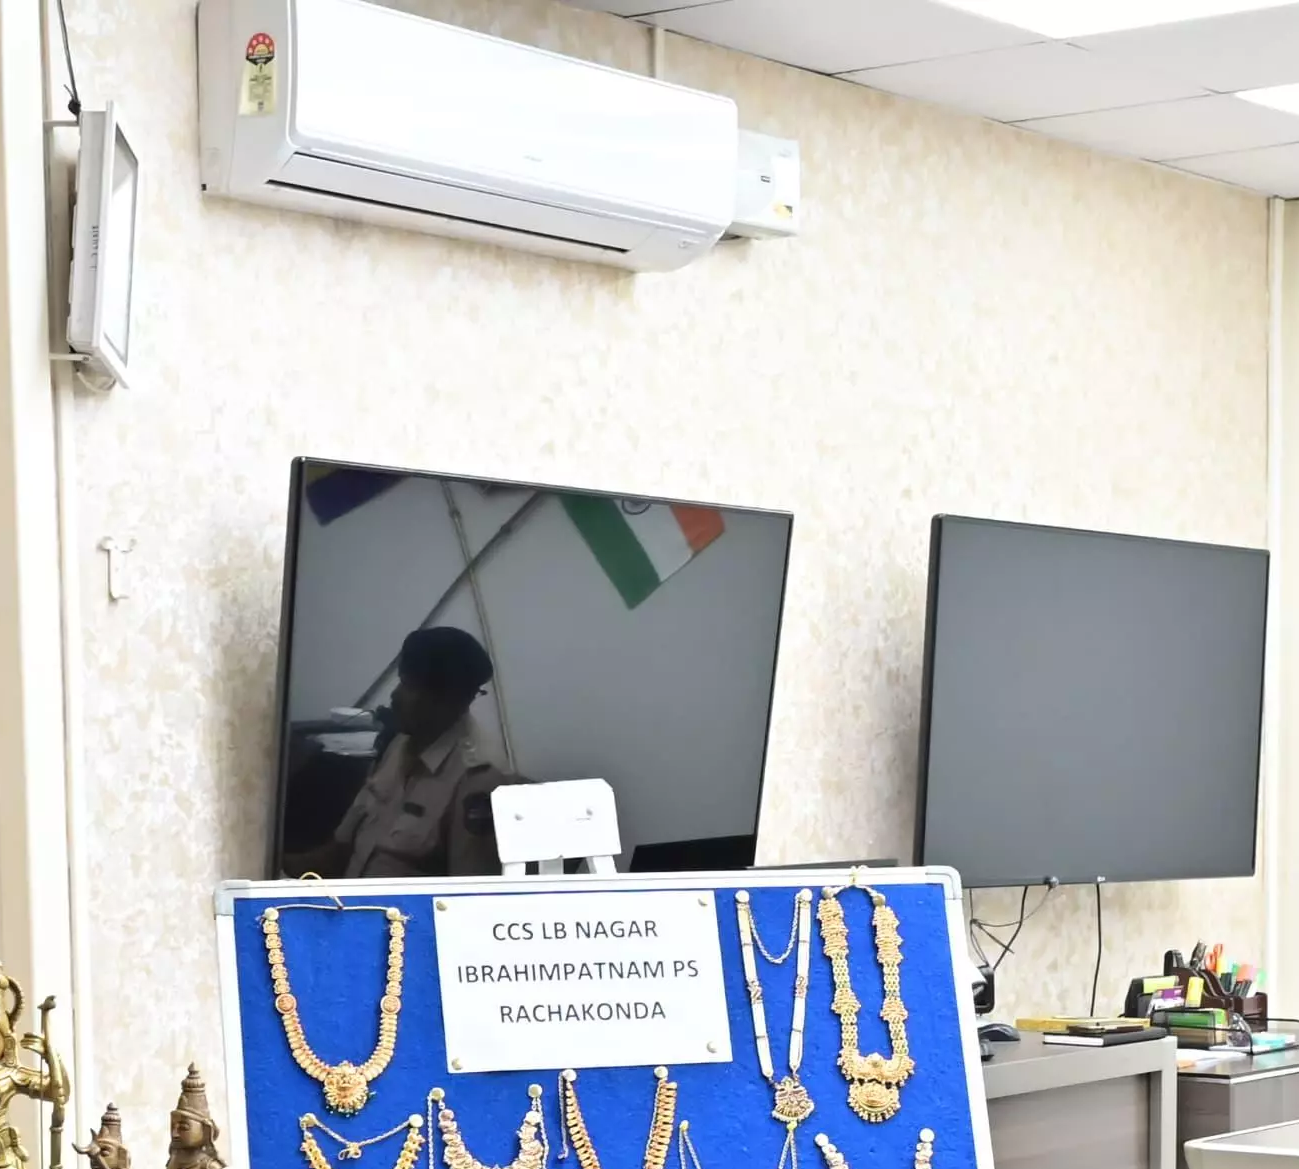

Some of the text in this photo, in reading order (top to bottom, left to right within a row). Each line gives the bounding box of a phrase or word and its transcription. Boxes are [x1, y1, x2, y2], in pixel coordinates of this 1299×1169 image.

[492, 920, 658, 941] CCS LB NAGAR
[457, 959, 699, 983] IBRAHIMPATNAM PS
[499, 1001, 666, 1023] RACHAKONDA
